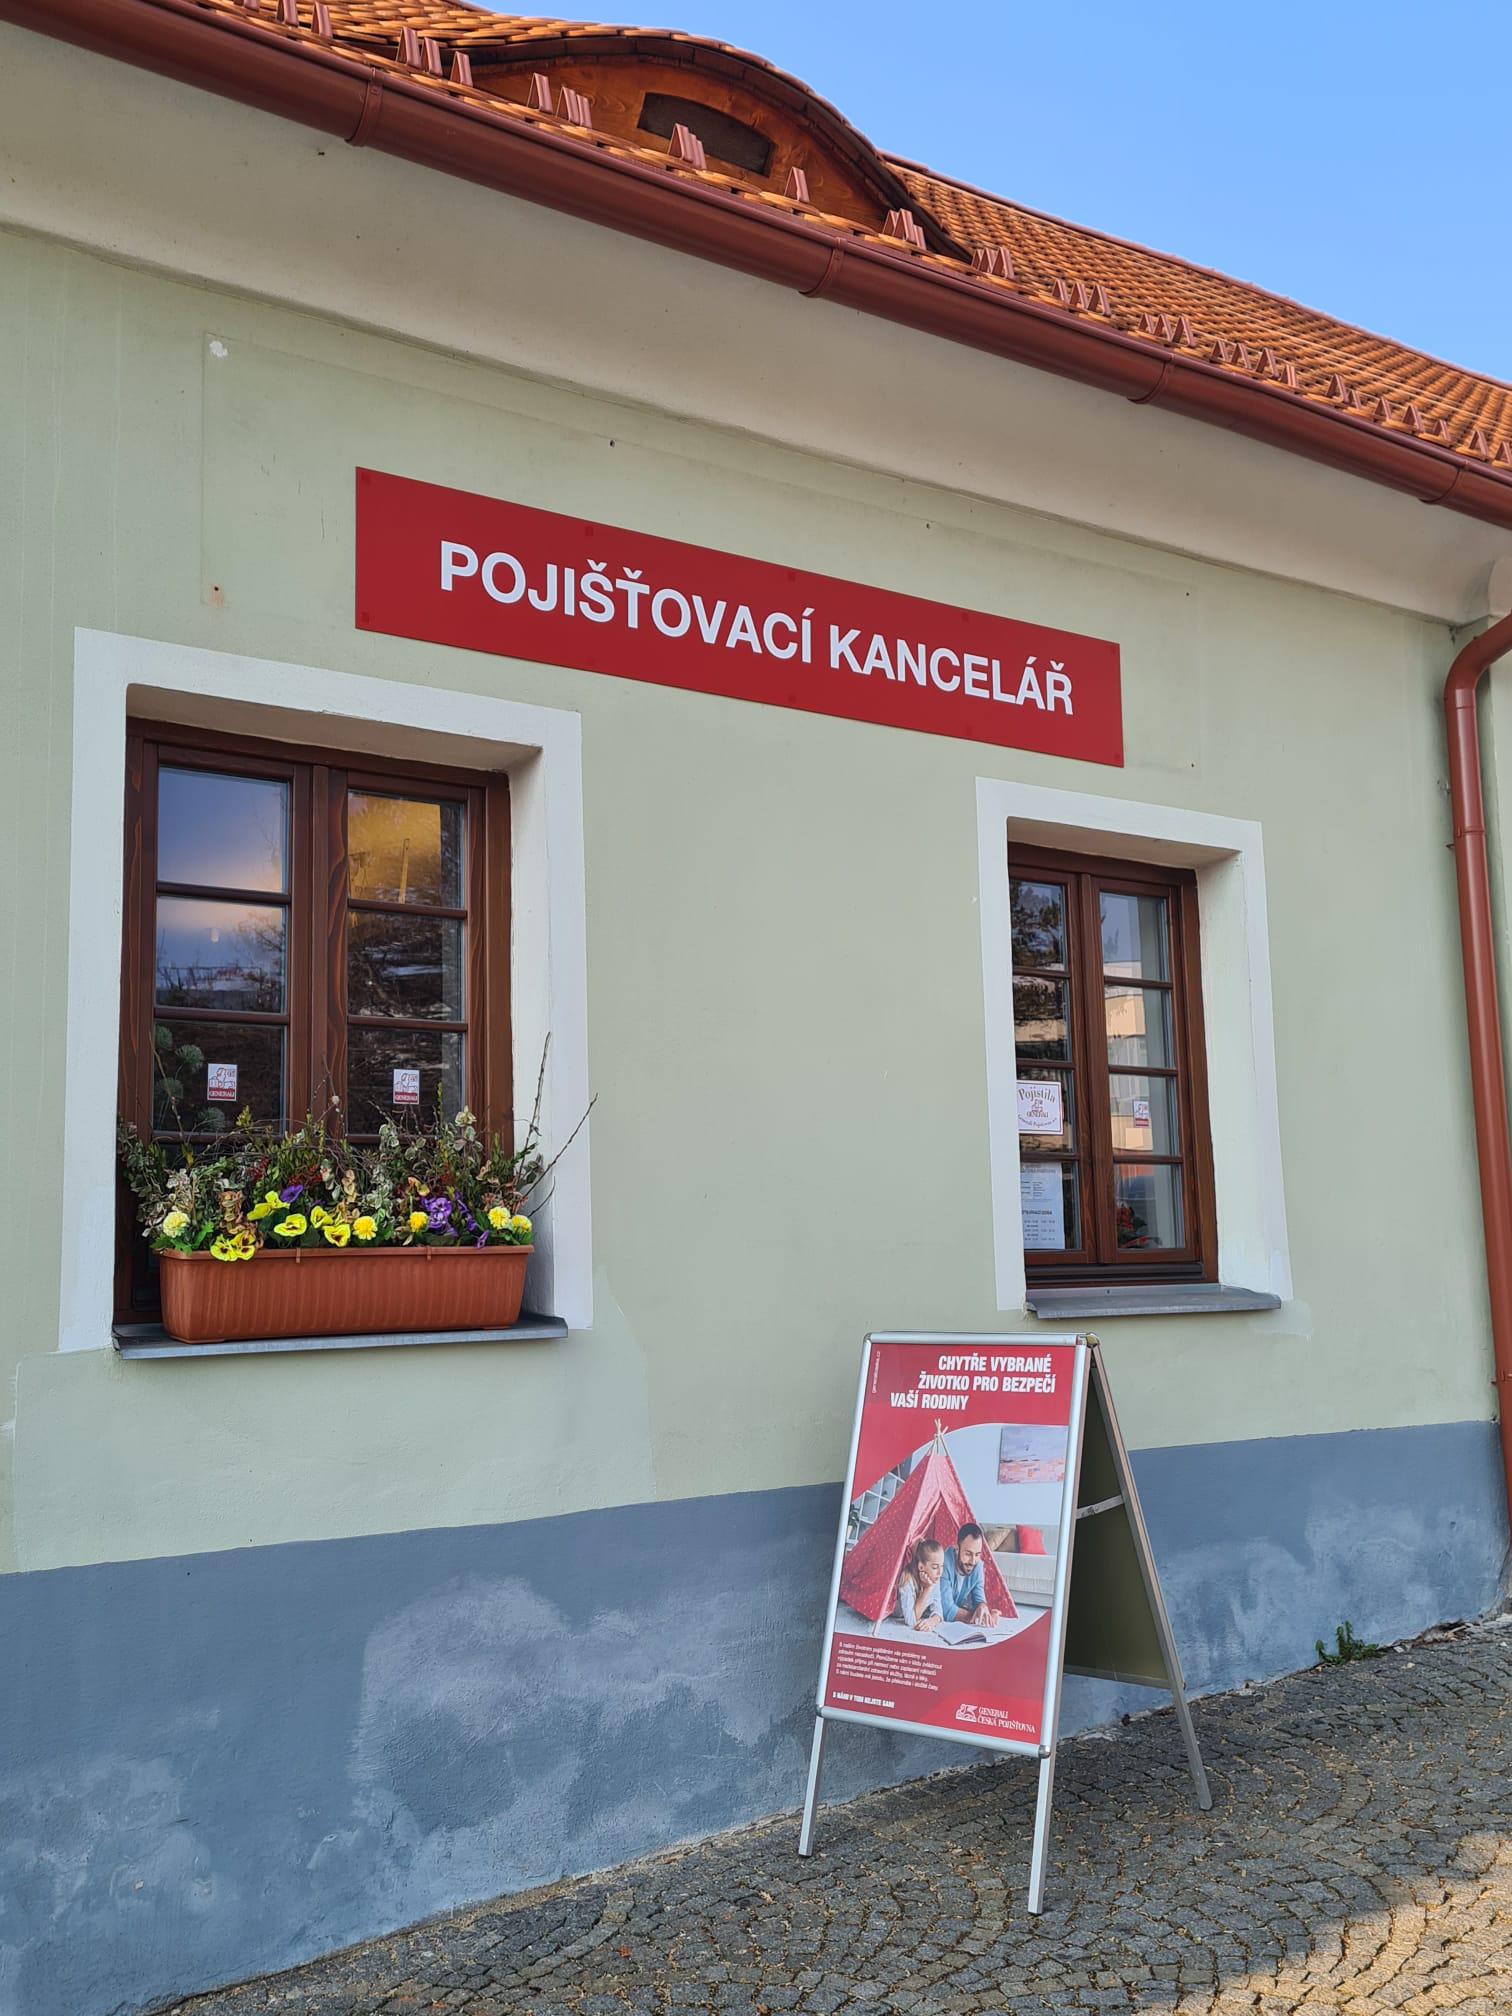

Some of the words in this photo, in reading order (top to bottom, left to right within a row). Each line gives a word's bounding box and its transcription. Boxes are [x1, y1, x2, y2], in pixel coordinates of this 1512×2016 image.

[440, 540, 812, 663] POJIŠŤOVACÍ
[829, 625, 1073, 715] KANCELÁŘ
[938, 1353, 986, 1371] CHYTŘE
[991, 1354, 1052, 1373] VYBRANÉ
[918, 1371, 970, 1391] ŽIVOTKO
[973, 1377, 998, 1392] PRO
[1002, 1374, 1056, 1393] BEZPEČÍ
[890, 1390, 919, 1408] VAŠÍ
[922, 1394, 969, 1411] RODINY
[978, 1707, 1009, 1719] GENERALI
